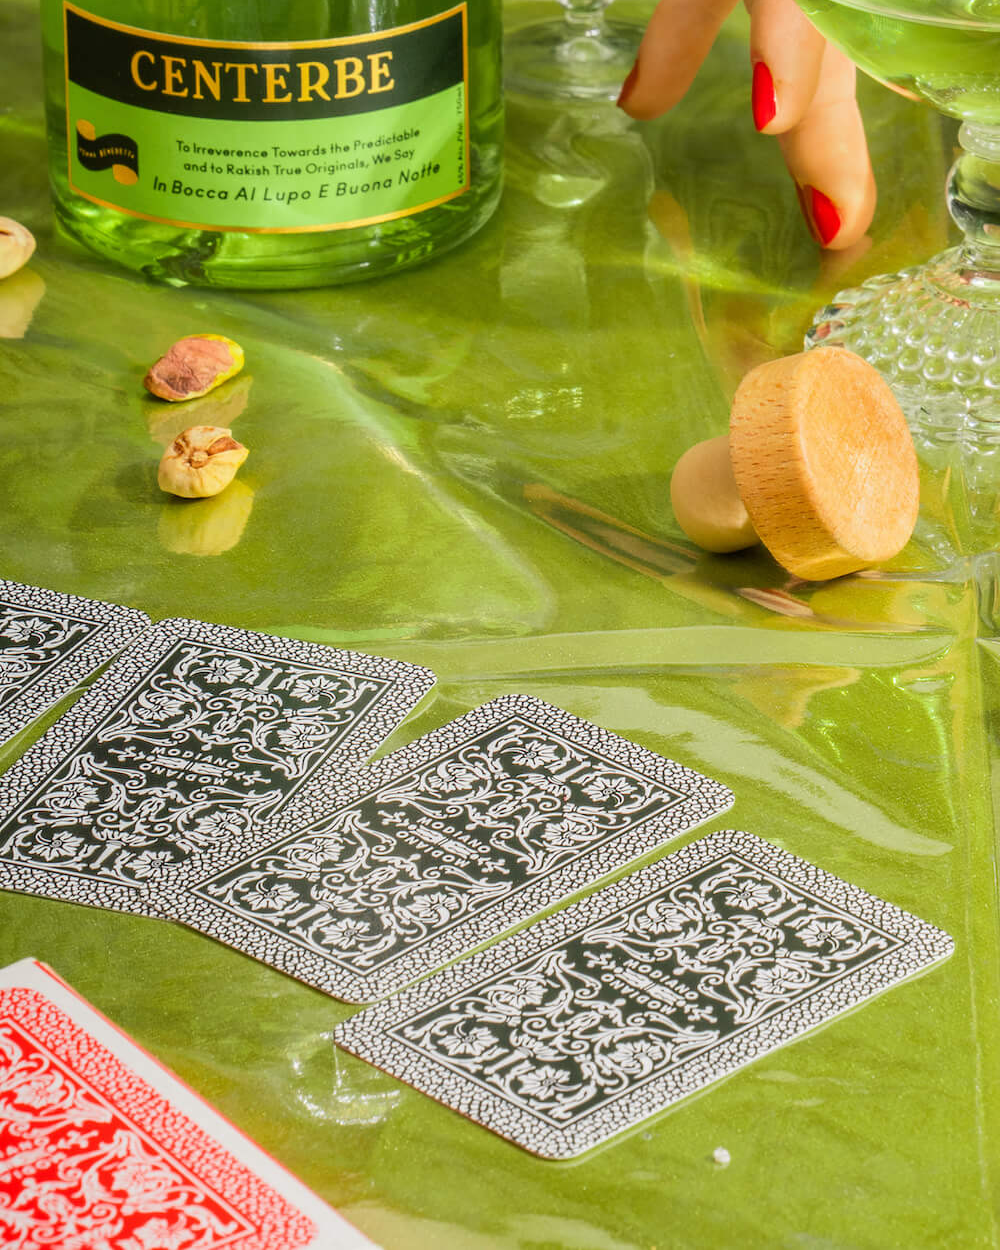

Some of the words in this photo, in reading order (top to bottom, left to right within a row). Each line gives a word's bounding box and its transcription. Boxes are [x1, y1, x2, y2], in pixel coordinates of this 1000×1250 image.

[130, 50, 395, 104] CENTERBE
[176, 140, 191, 152] To
[193, 143, 268, 158] Irreverence
[272, 145, 327, 158] Towards
[330, 143, 350, 154] the
[353, 128, 420, 151] Predictable
[183, 162, 207, 173] and
[210, 163, 223, 174] to
[226, 164, 270, 176] Rakish
[274, 165, 302, 175] True
[305, 159, 369, 176] Originals,
[372, 154, 391, 165] We
[394, 149, 416, 161] Say
[153, 176, 167, 193] In
[171, 180, 228, 201] Bocca
[234, 187, 256, 201] Al
[263, 187, 311, 205] Lupo
[318, 184, 329, 199] E
[335, 181, 392, 197] Buona
[398, 161, 440, 185] Notte
[139, 762, 228, 786] MODIANO
[150, 746, 240, 769] MODIANO
[395, 830, 471, 868] MODIANO
[416, 816, 491, 854] MODIANO
[600, 972, 677, 1015] MODIANO
[622, 958, 699, 1001] MODIANO
